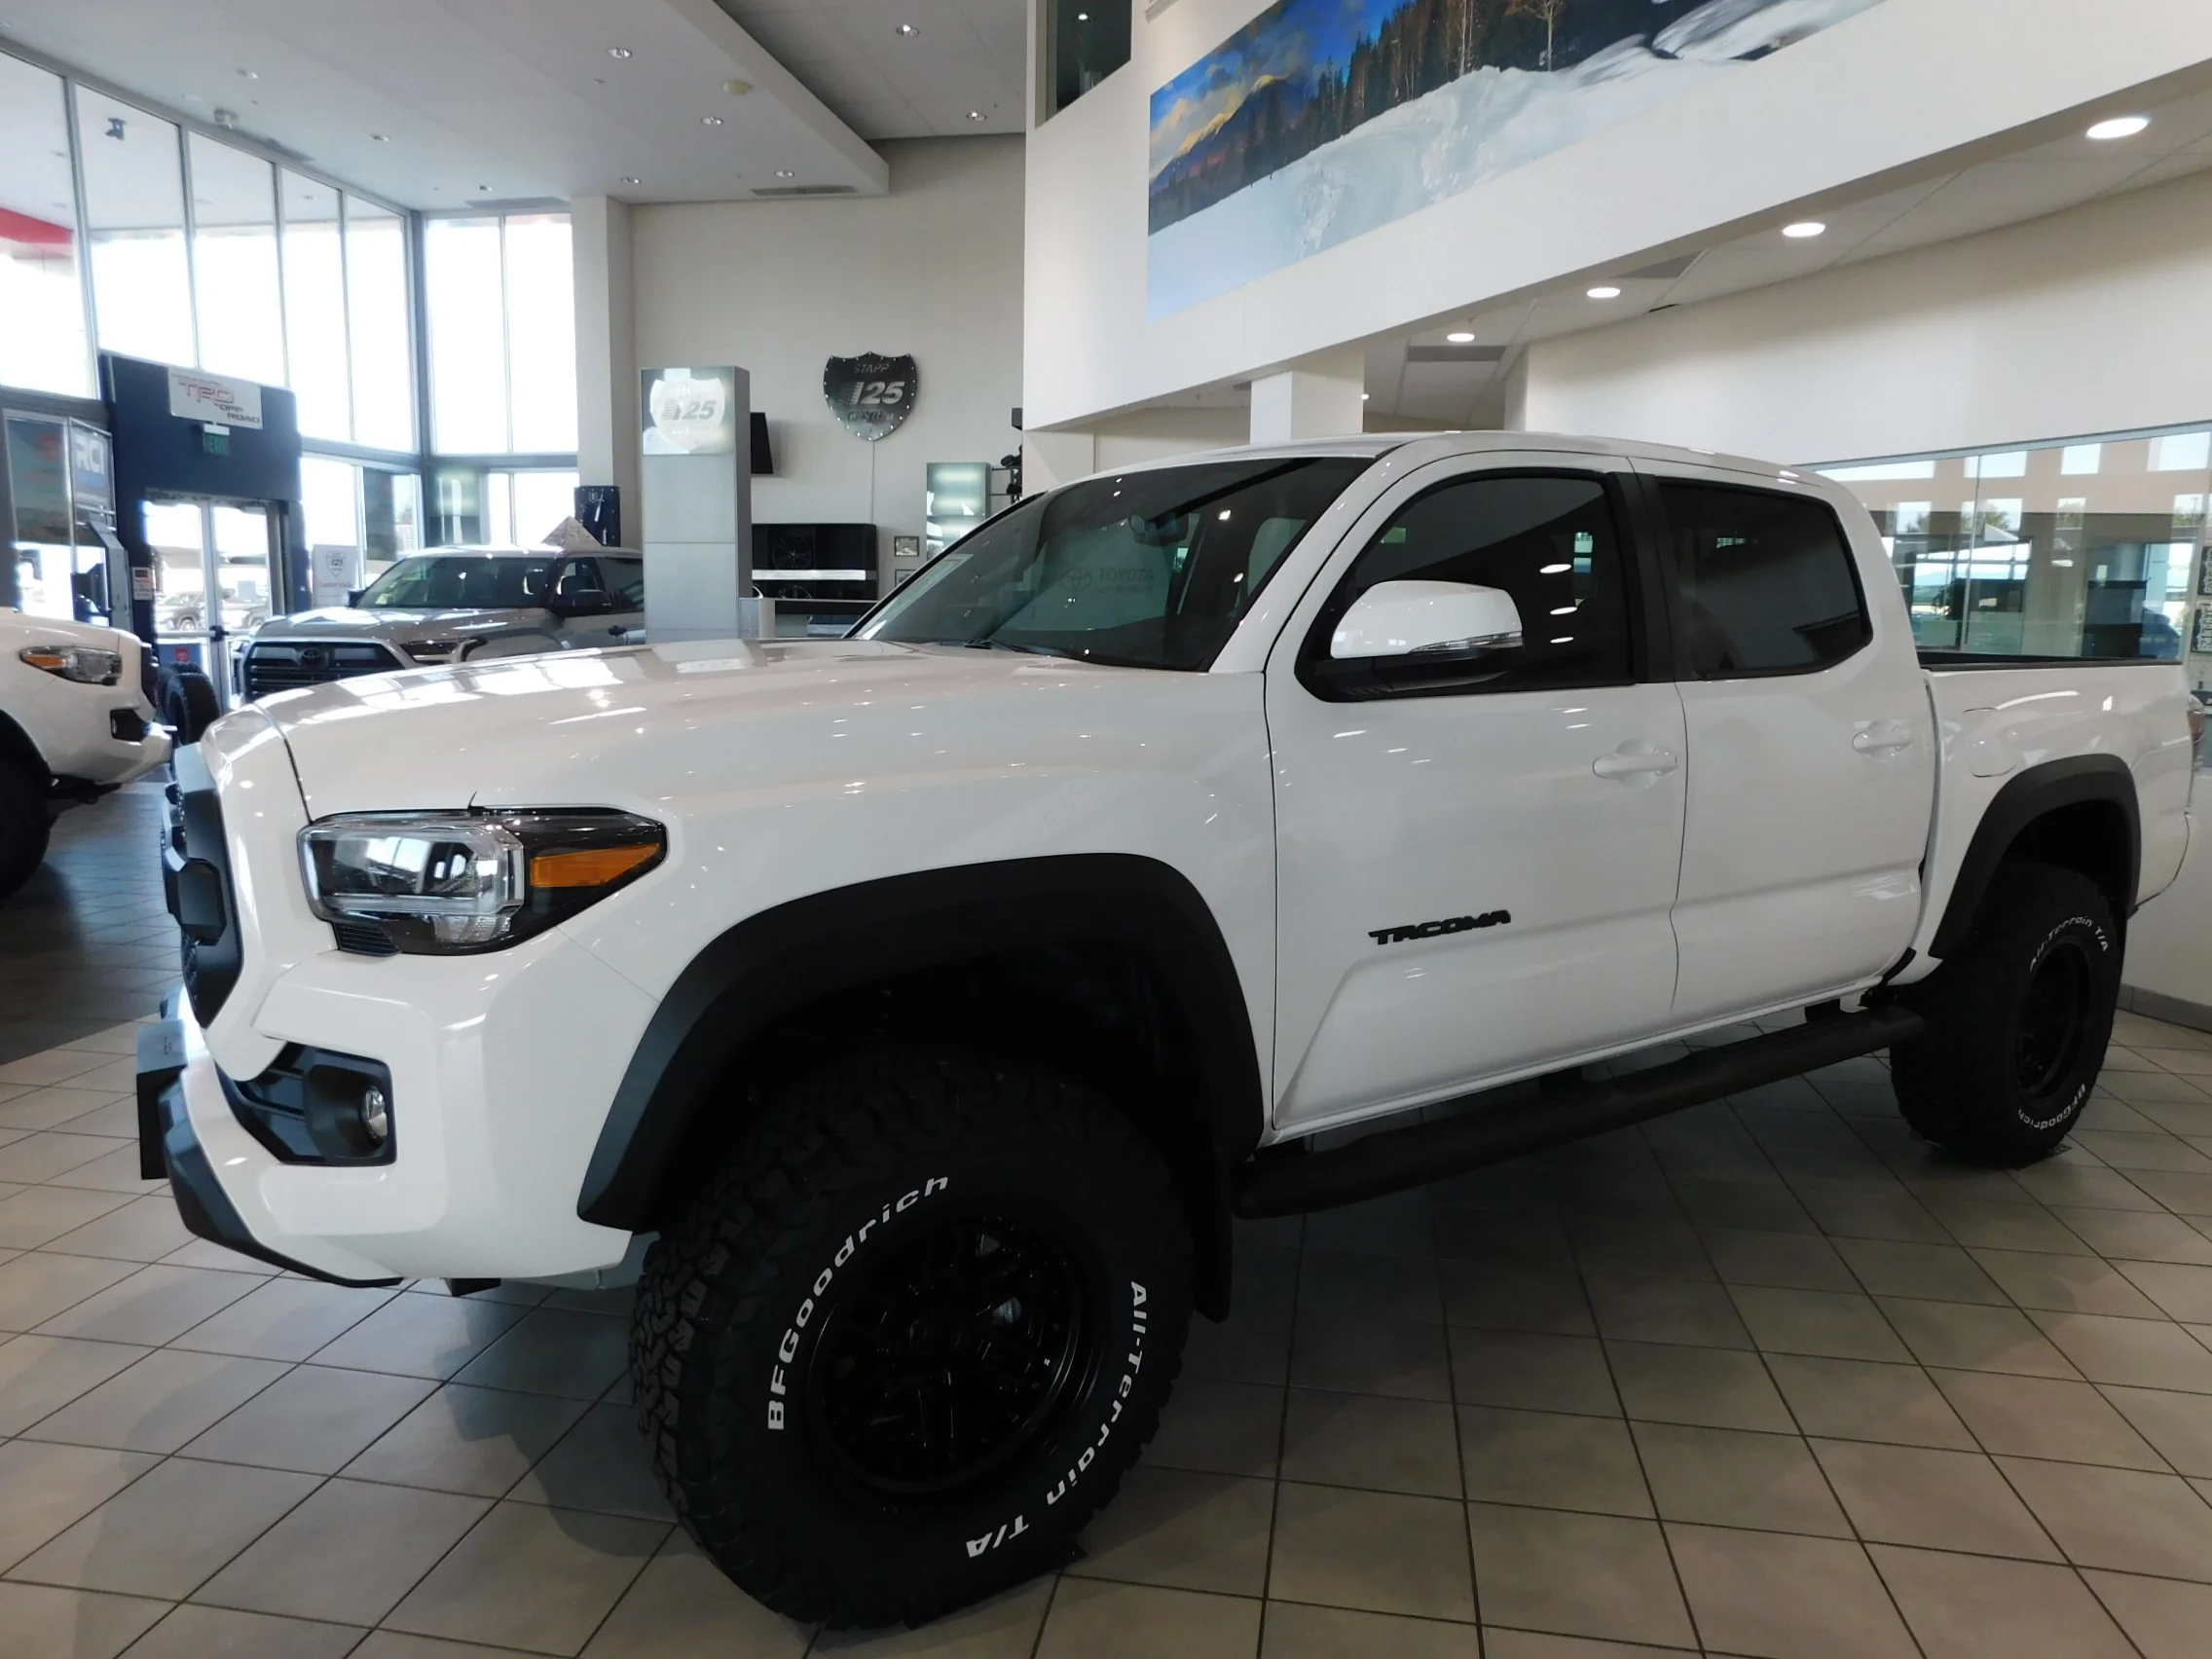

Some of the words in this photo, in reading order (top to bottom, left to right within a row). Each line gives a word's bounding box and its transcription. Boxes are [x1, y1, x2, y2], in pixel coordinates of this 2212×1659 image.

[177, 376, 235, 403] TRD
[218, 403, 244, 413] OFF
[227, 413, 261, 424] ROAD
[1097, 567, 1155, 582] TOYOTA
[1367, 908, 1512, 945] TACOMA
[2094, 925, 2109, 952] T/A
[767, 1176, 949, 1431] BFGoodrich
[1046, 1280, 1148, 1505] All-Terrain
[965, 1515, 1029, 1558] T/A
